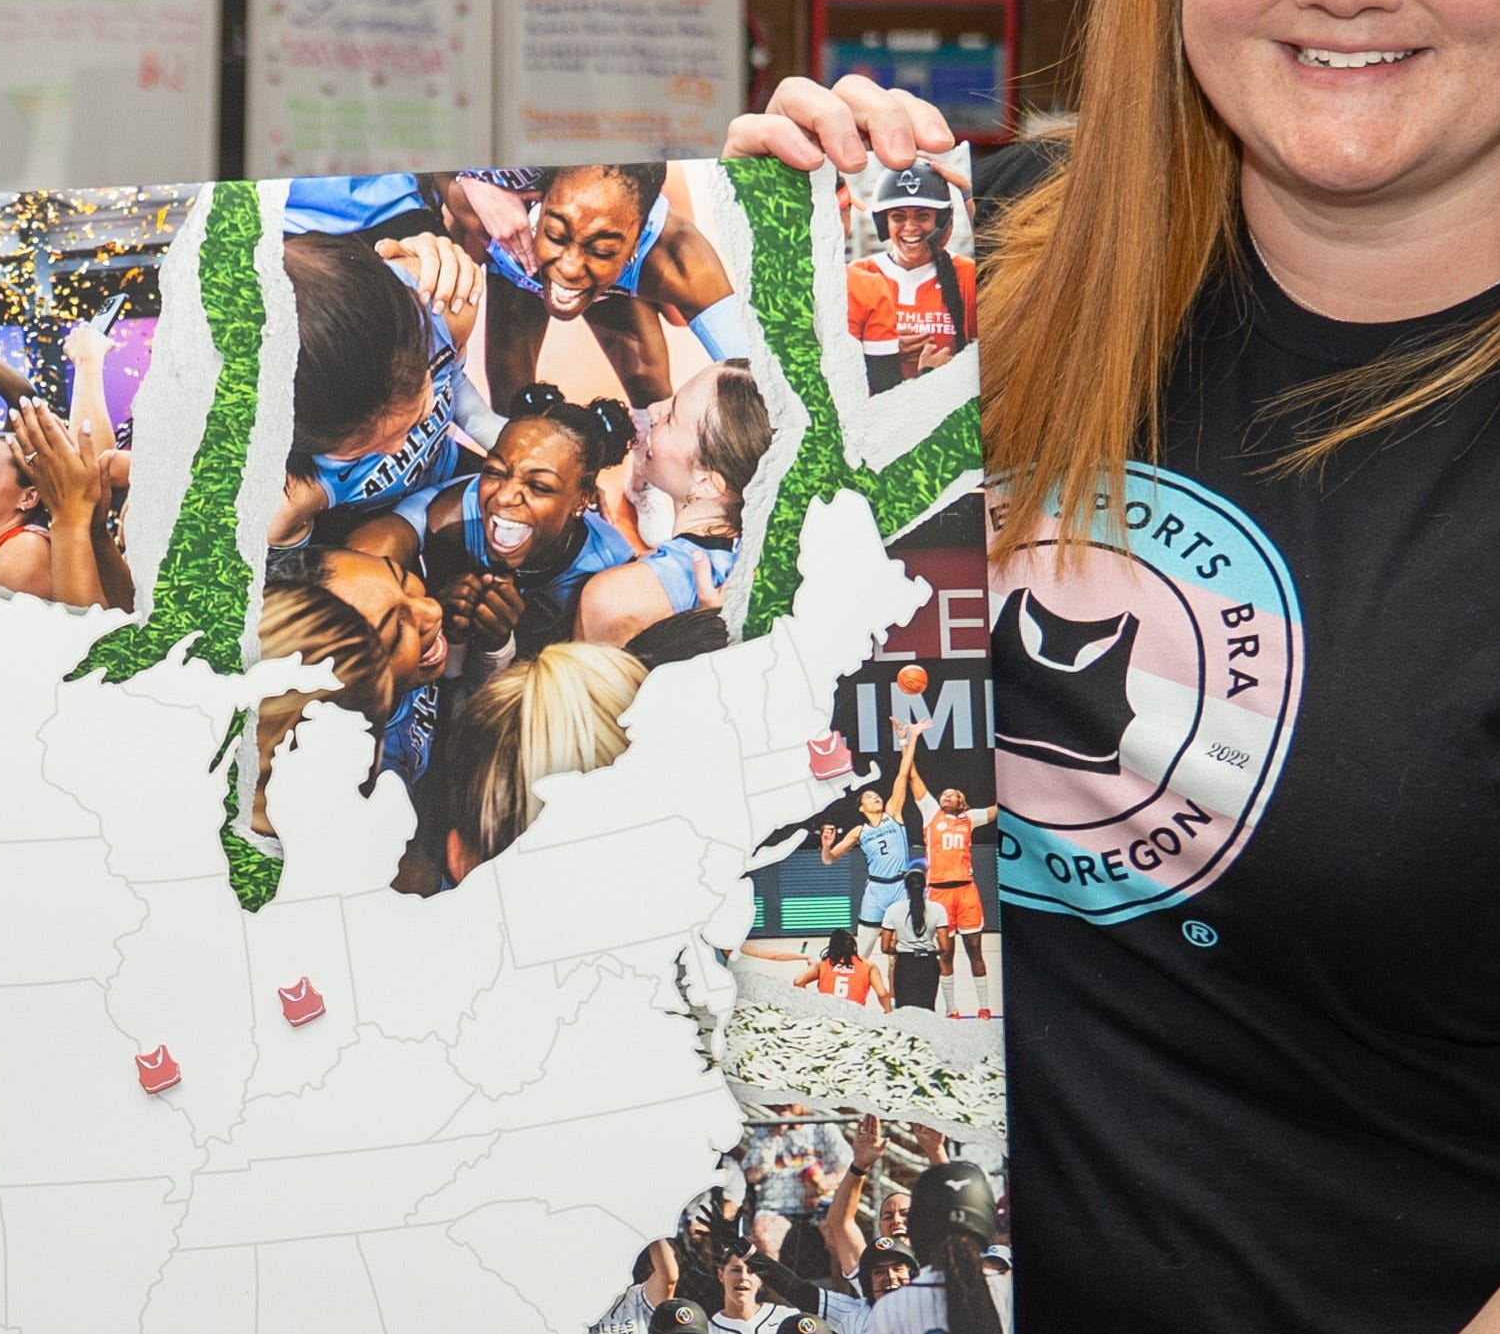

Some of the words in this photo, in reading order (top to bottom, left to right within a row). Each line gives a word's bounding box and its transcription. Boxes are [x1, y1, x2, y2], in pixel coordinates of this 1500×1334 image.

[362, 381, 453, 499] ATHLETE
[1220, 601, 1260, 700] BRA
[1204, 740, 1251, 770] 2022
[878, 840, 889, 856] 2
[1044, 797, 1213, 887] OREGON
[833, 976, 849, 998] 6
